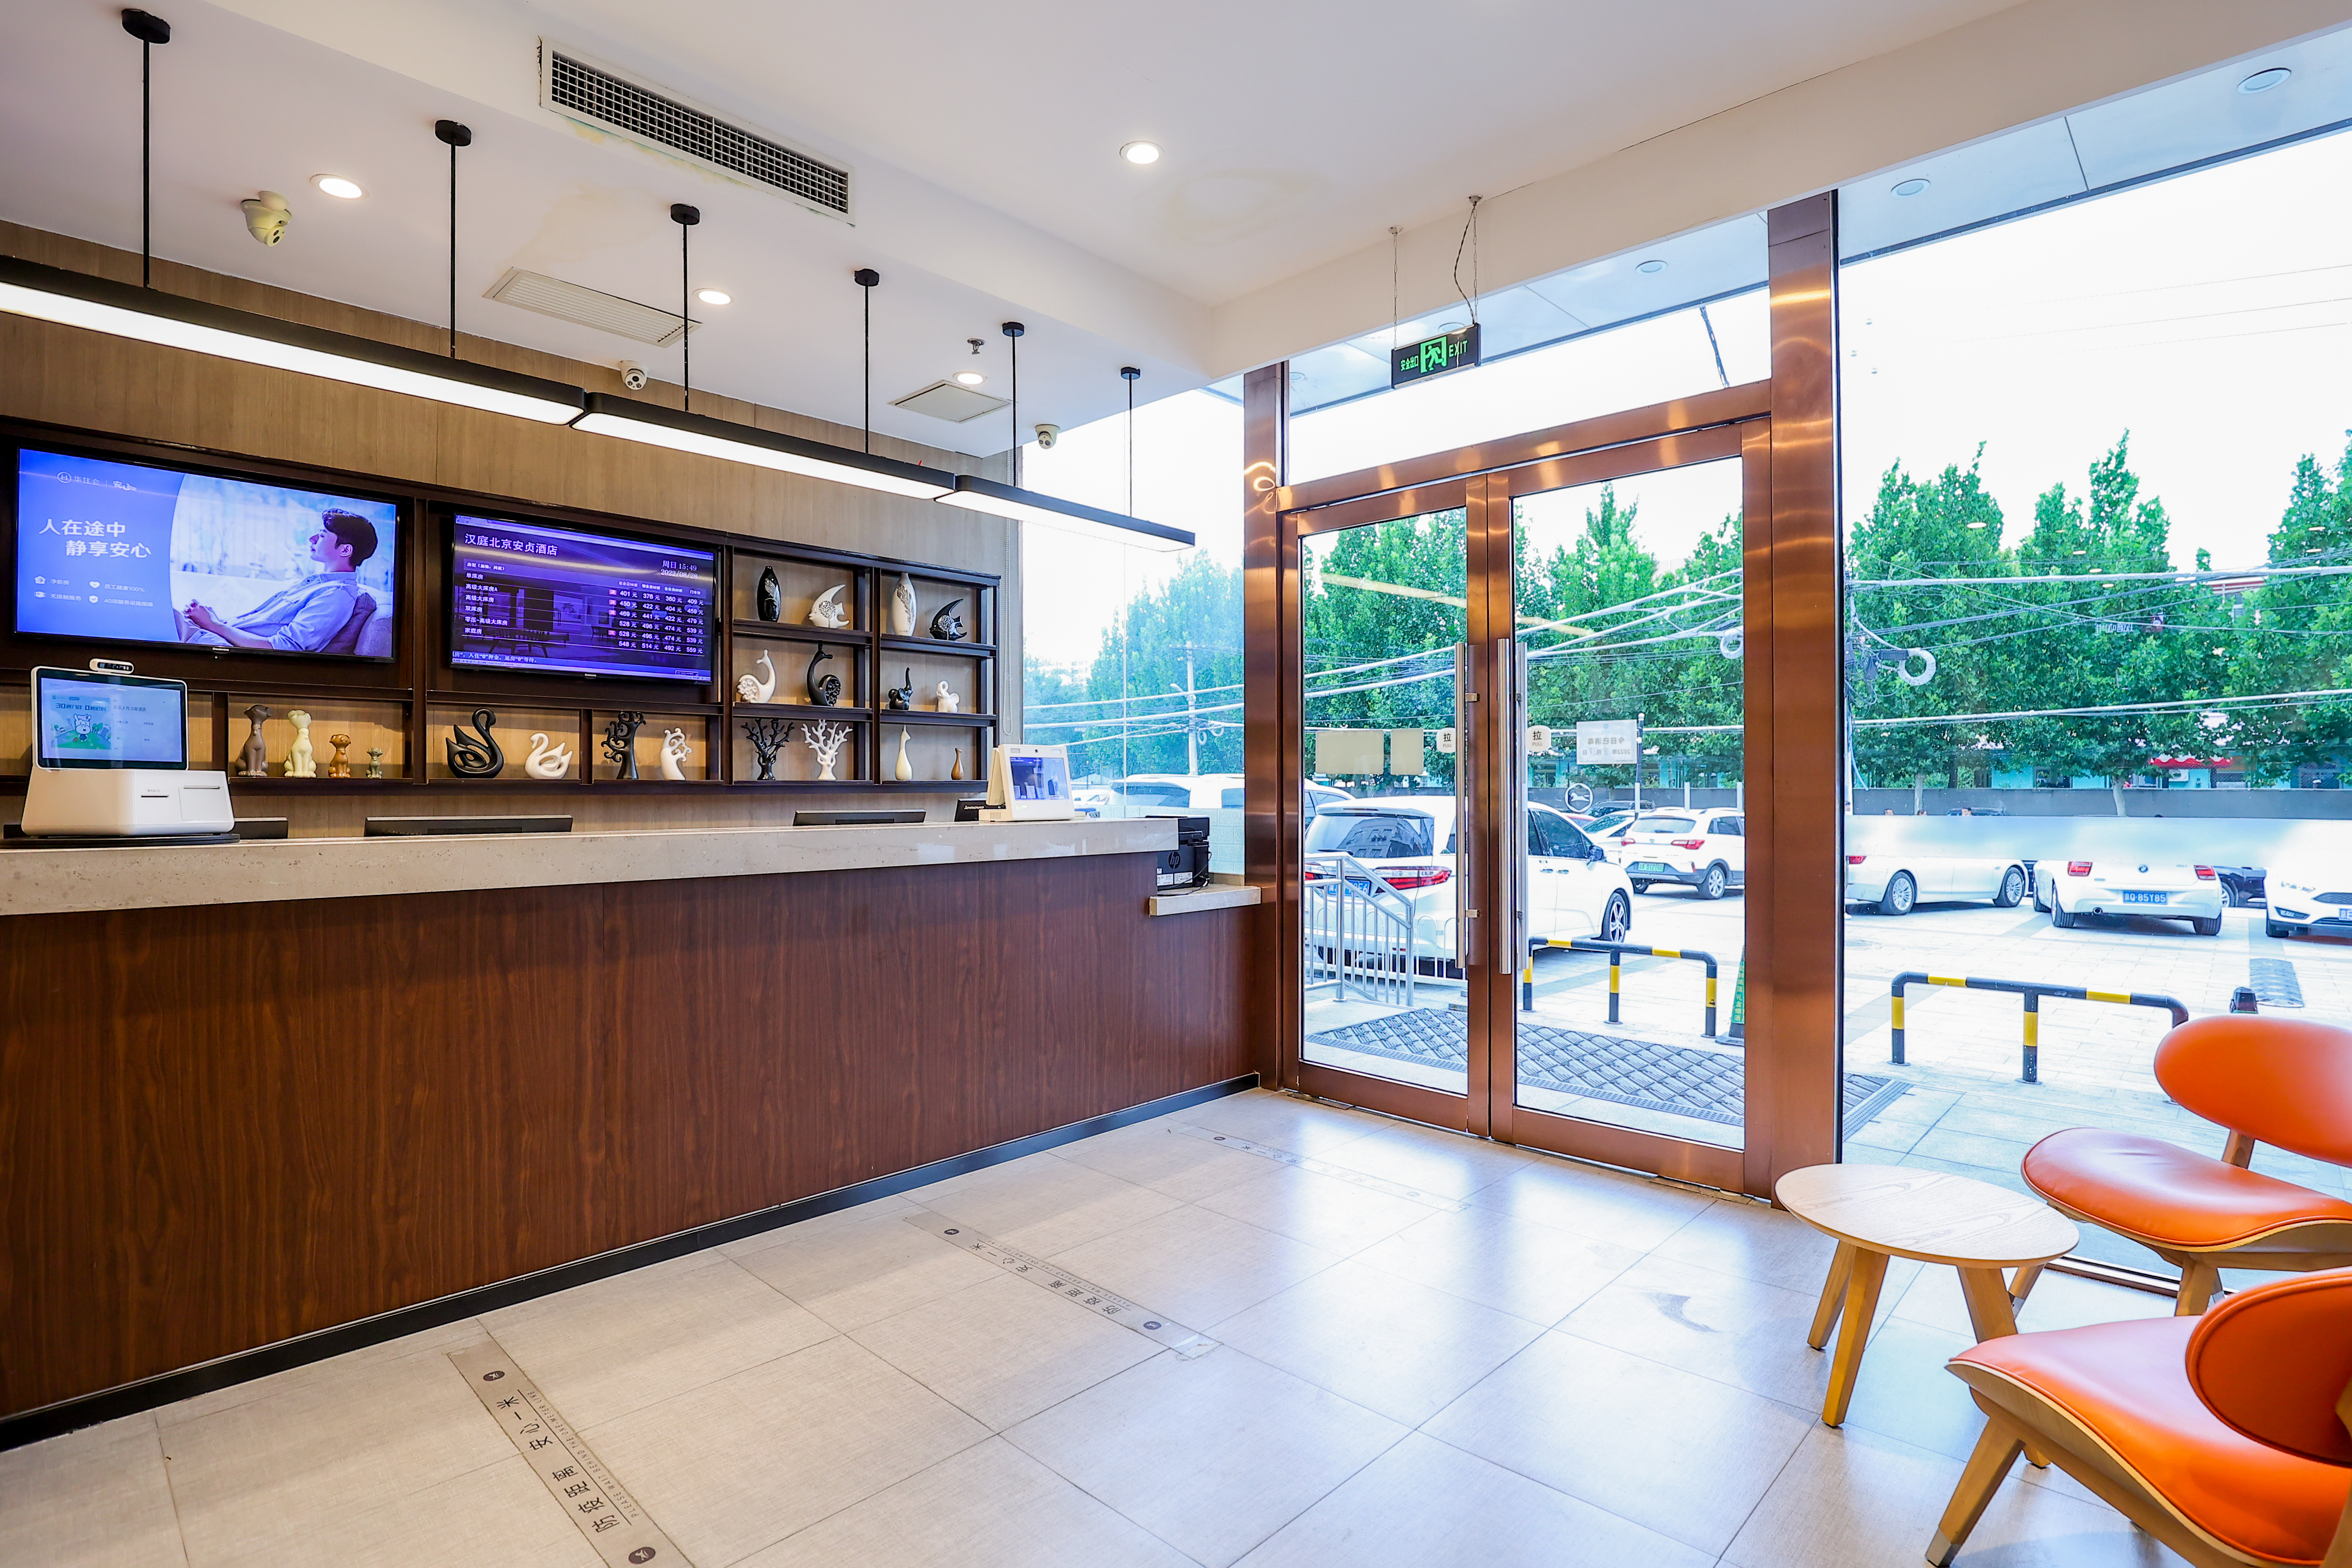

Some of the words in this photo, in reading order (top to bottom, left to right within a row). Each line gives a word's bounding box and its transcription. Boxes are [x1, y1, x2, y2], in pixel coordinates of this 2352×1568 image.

[1449, 340, 1468, 358] EXIT
[1400, 355, 1419, 371] 安全出口
[74, 476, 100, 486] 华住会
[39, 518, 126, 537] 人在途中
[65, 540, 152, 558] 静享安心
[465, 533, 558, 556] 汉庭北京安贞酒店
[662, 560, 677, 569] 周日
[660, 569, 698, 579] 2022/08/28
[466, 583, 498, 592] 高级大床房A
[465, 594, 494, 603] 高级大床房
[1443, 732, 1452, 742] 拉
[1533, 731, 1542, 740] 拉
[1170, 851, 1179, 869] hp
[969, 1243, 1033, 1273] 安心一米
[1048, 1280, 1122, 1315] 防疫距离
[527, 1390, 542, 1403] LINE
[496, 1396, 553, 1451] 安心一米
[566, 1436, 579, 1450] THE
[577, 1449, 600, 1473] BEHIND
[597, 1474, 616, 1491] WAIT
[553, 1465, 620, 1533] 防疫距离
[613, 1491, 639, 1518] PLEASE
